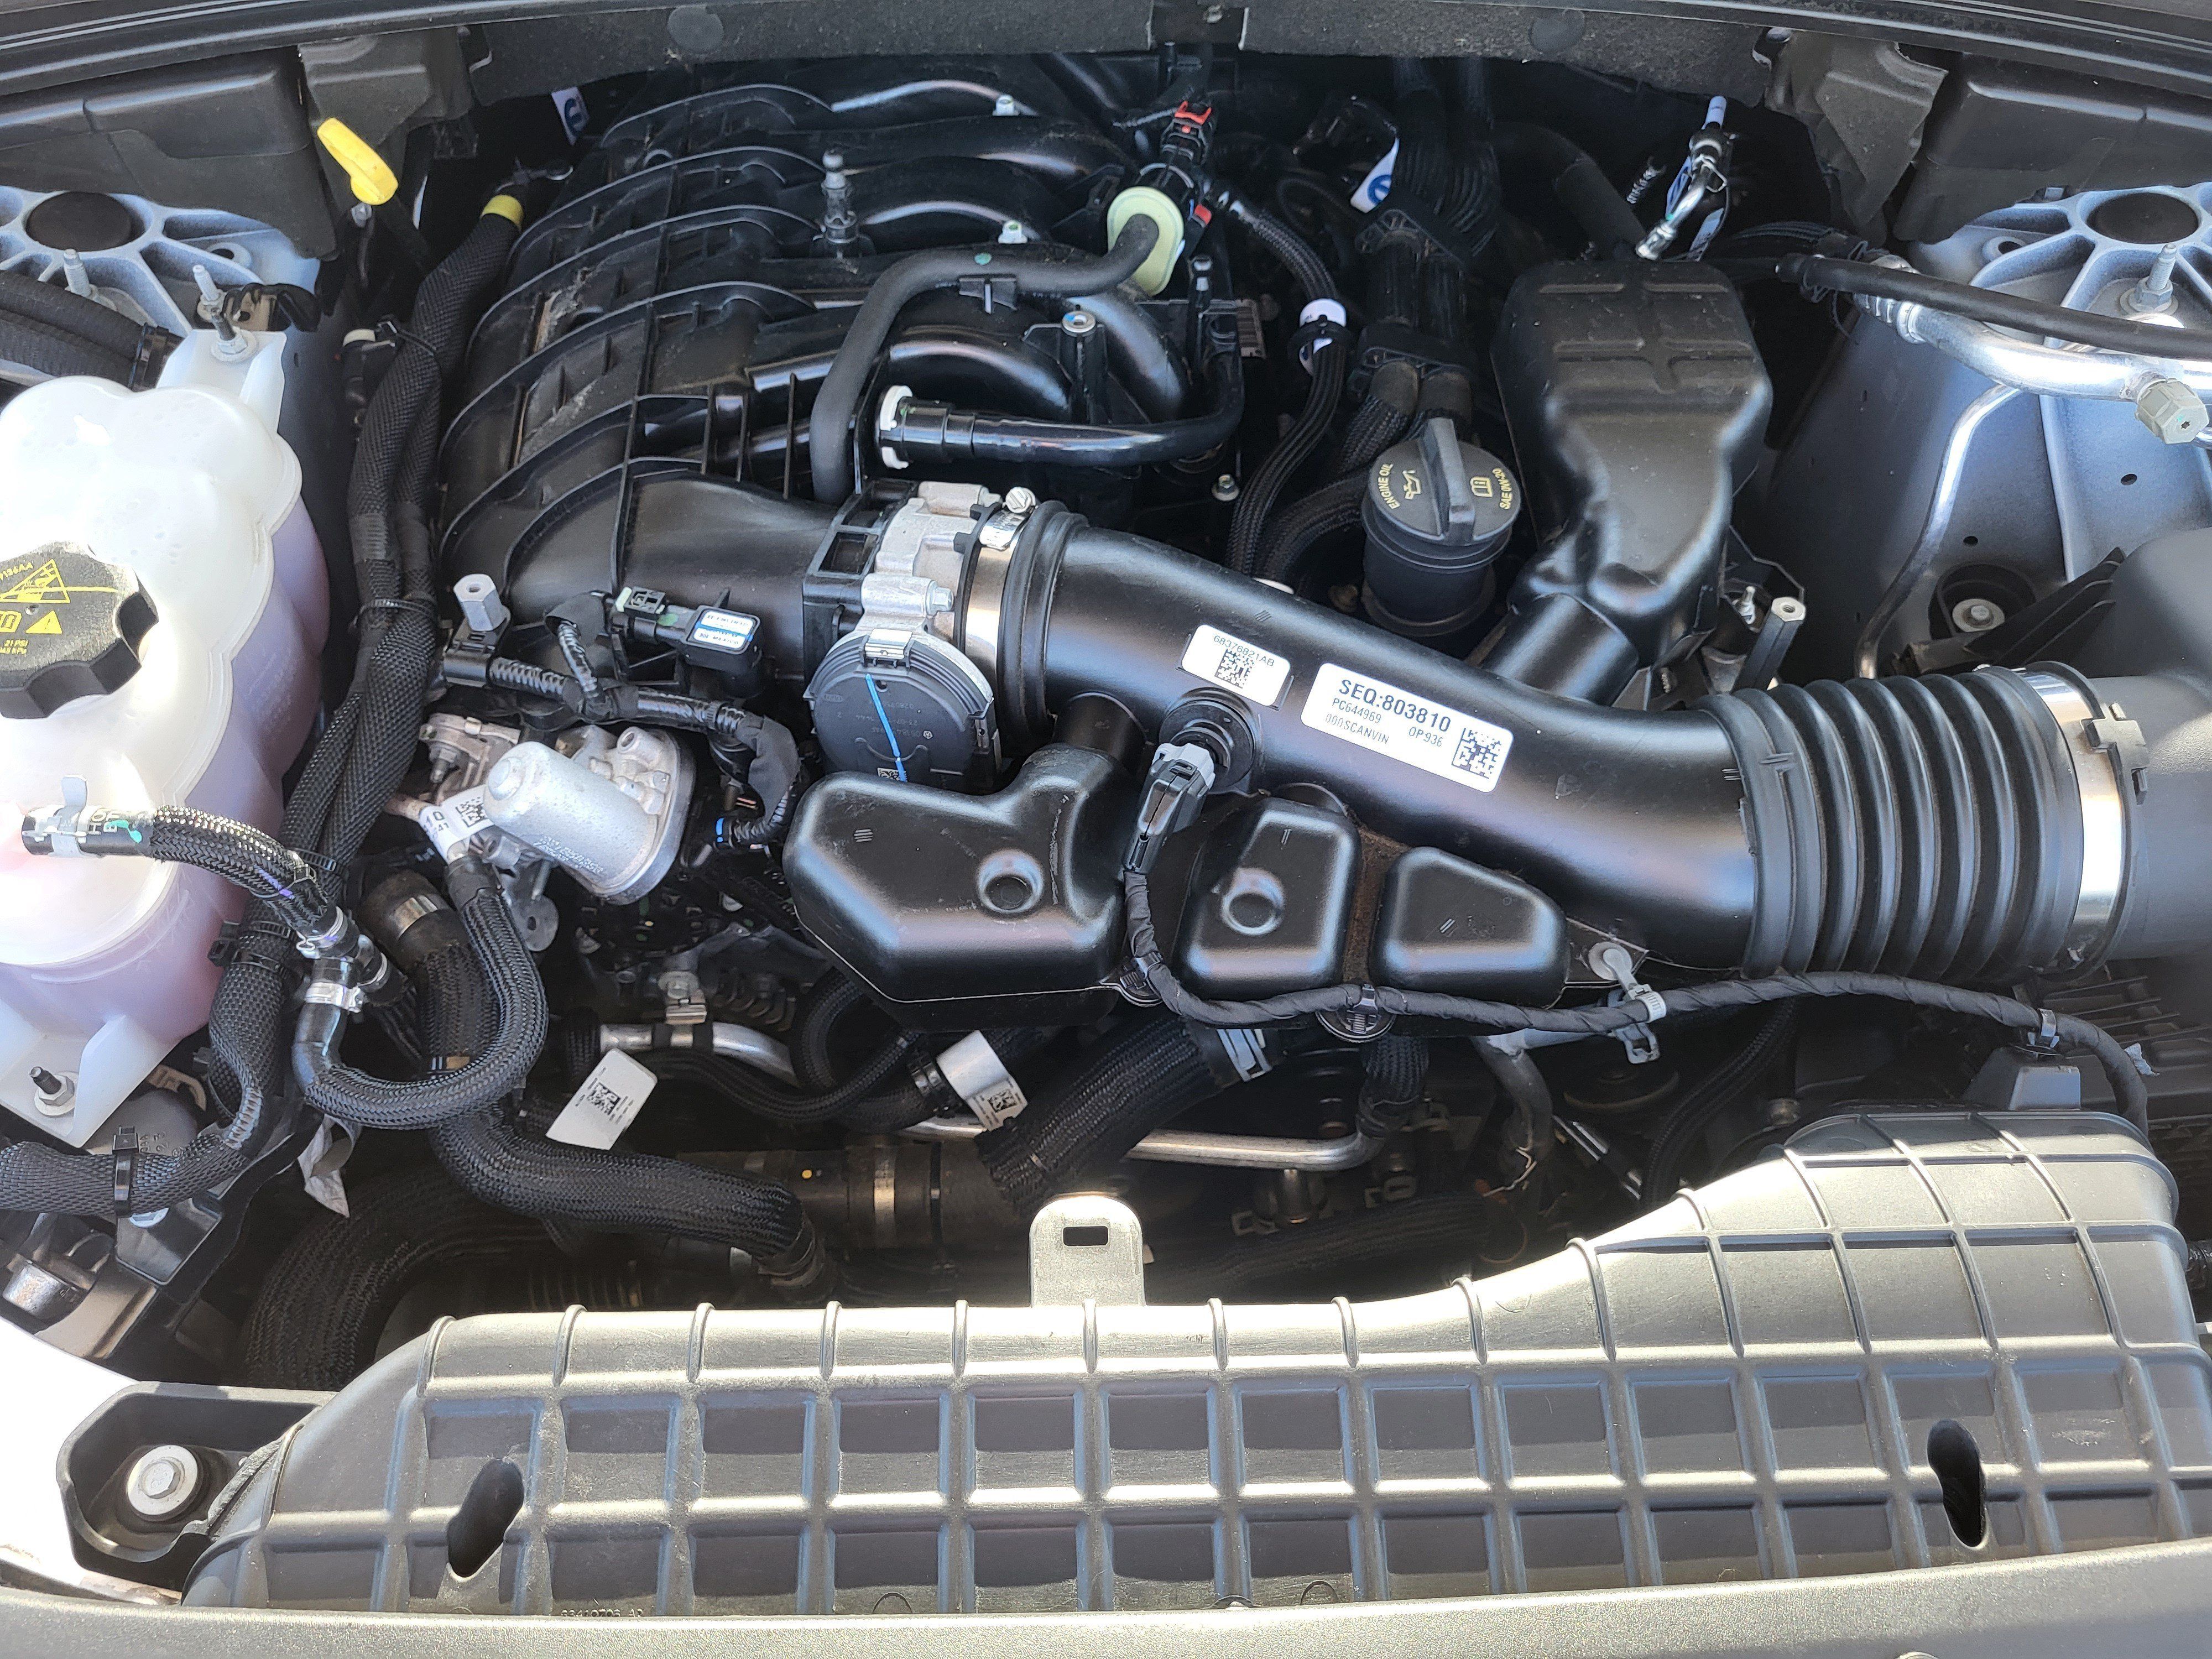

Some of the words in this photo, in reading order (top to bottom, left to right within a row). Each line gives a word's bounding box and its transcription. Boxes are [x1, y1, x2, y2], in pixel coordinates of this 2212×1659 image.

[1379, 462, 1394, 477] OIL
[1491, 467, 1512, 493] 0W-20
[1378, 476, 1401, 509] ENGINE
[1499, 492, 1512, 510] SAE
[1213, 635, 1275, 666] 68376821AB
[1332, 697, 1382, 724] PC644969
[1338, 679, 1452, 733] SEQ:803810
[1325, 713, 1390, 745] 000SCANVIN
